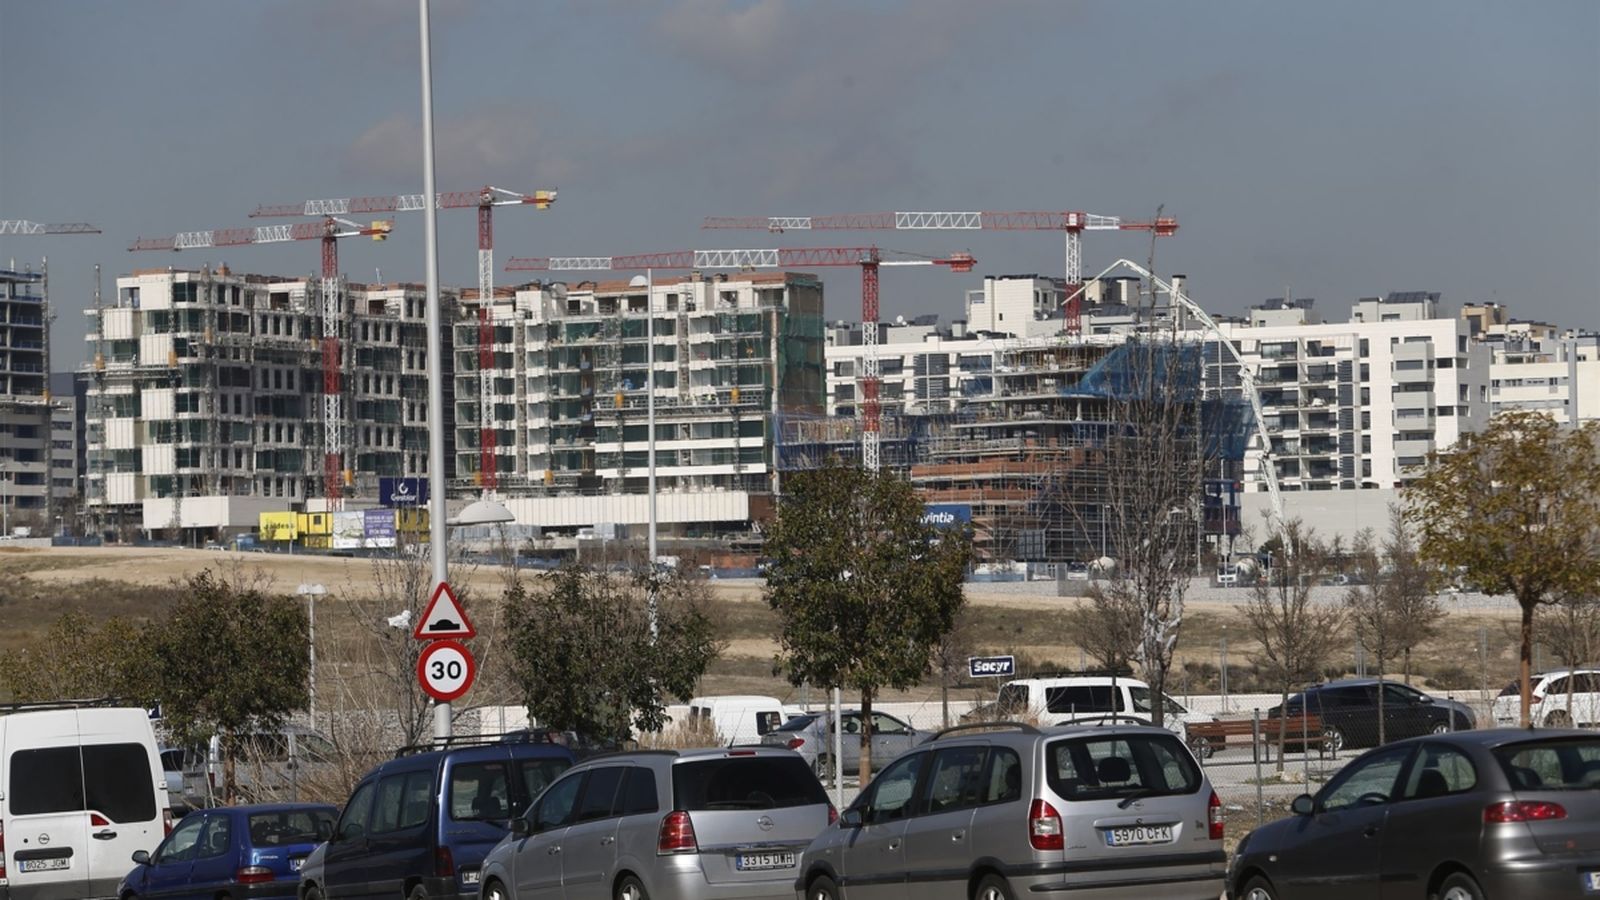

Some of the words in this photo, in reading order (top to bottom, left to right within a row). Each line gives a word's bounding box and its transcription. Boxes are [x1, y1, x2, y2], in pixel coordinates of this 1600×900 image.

[431, 661, 462, 680] 30
[974, 661, 1010, 673] Sacyr
[1114, 828, 1144, 842] 5970
[1147, 826, 1169, 840] CFK
[26, 860, 47, 870] 8025
[744, 854, 770, 866] 3315
